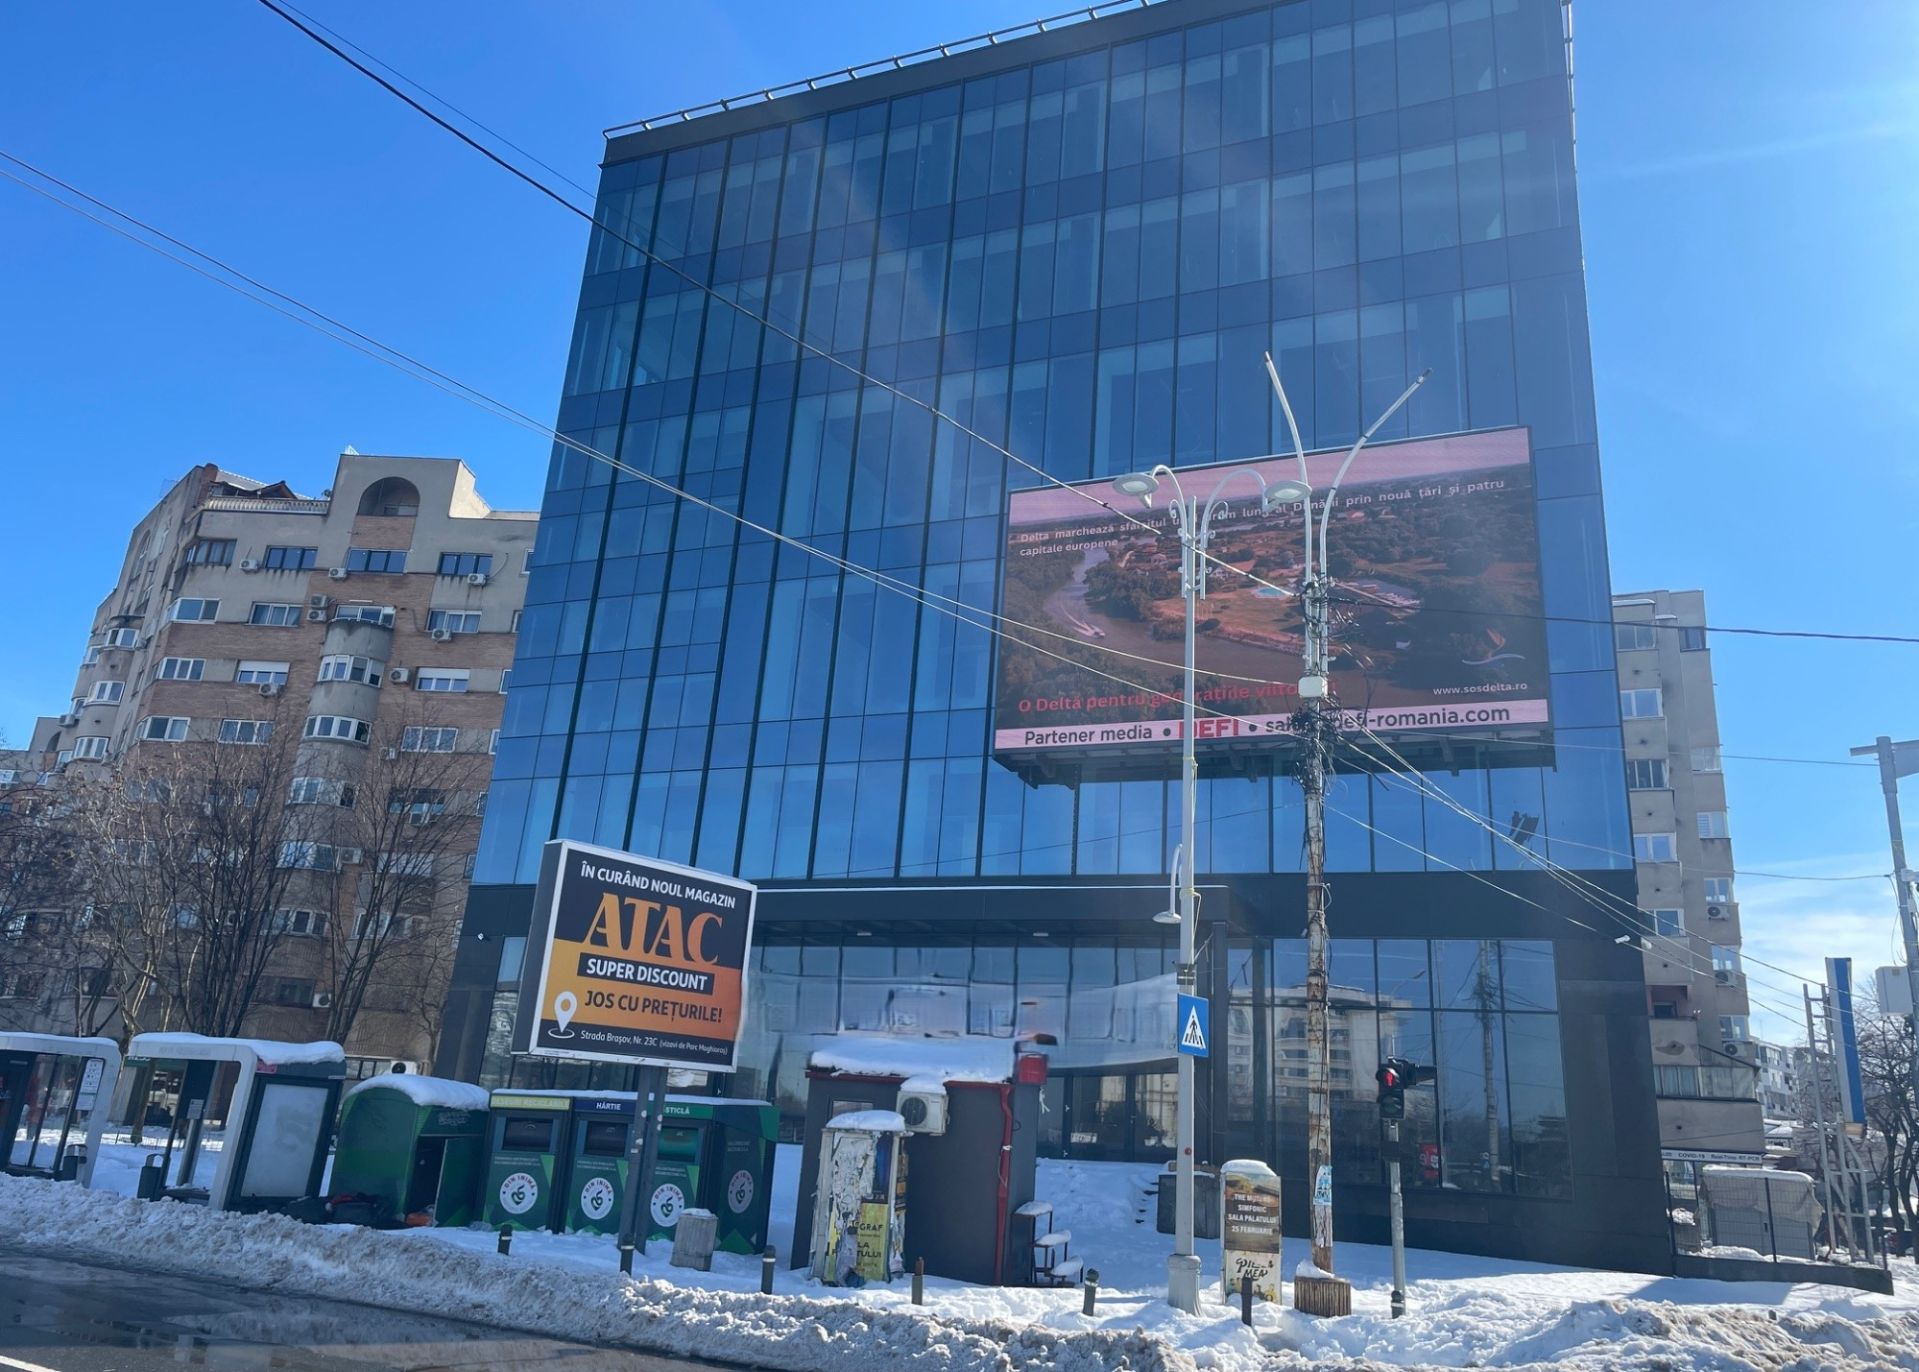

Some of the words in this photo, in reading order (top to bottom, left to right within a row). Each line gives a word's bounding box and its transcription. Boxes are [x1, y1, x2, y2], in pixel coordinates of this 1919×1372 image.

[1021, 532, 1049, 542] Delta
[1293, 498, 1339, 512] Dnăii
[1345, 494, 1372, 508] prin
[1379, 488, 1412, 501] nouă
[1467, 480, 1505, 494] patru
[1020, 543, 1063, 557] capitale
[1065, 539, 1119, 552] europene
[1019, 699, 1031, 712] O
[1086, 694, 1145, 711] pentru
[1151, 685, 1250, 709] genrațiile
[1433, 682, 1528, 696] www.sosdelta.ro
[1025, 730, 1096, 745] Partener
[1100, 725, 1153, 741] media
[581, 861, 596, 879] ÎN
[597, 868, 650, 890] CURÂND
[650, 879, 683, 898] NOUL
[685, 886, 736, 909] MAGAZIN
[583, 892, 723, 965] ATAC
[586, 958, 637, 981] SUPER
[637, 967, 708, 991] DISCOUNT
[584, 991, 615, 1009] JOS
[618, 994, 640, 1012] CU
[642, 999, 723, 1023] PREȚURILE!
[580, 1030, 606, 1042] Strada
[606, 1033, 632, 1046] Brașov,
[633, 1036, 643, 1045] Nr.
[644, 1037, 658, 1047] 23C
[678, 1042, 686, 1050] de
[686, 1042, 698, 1051] Parc
[1228, 1213, 1244, 1221] SALA
